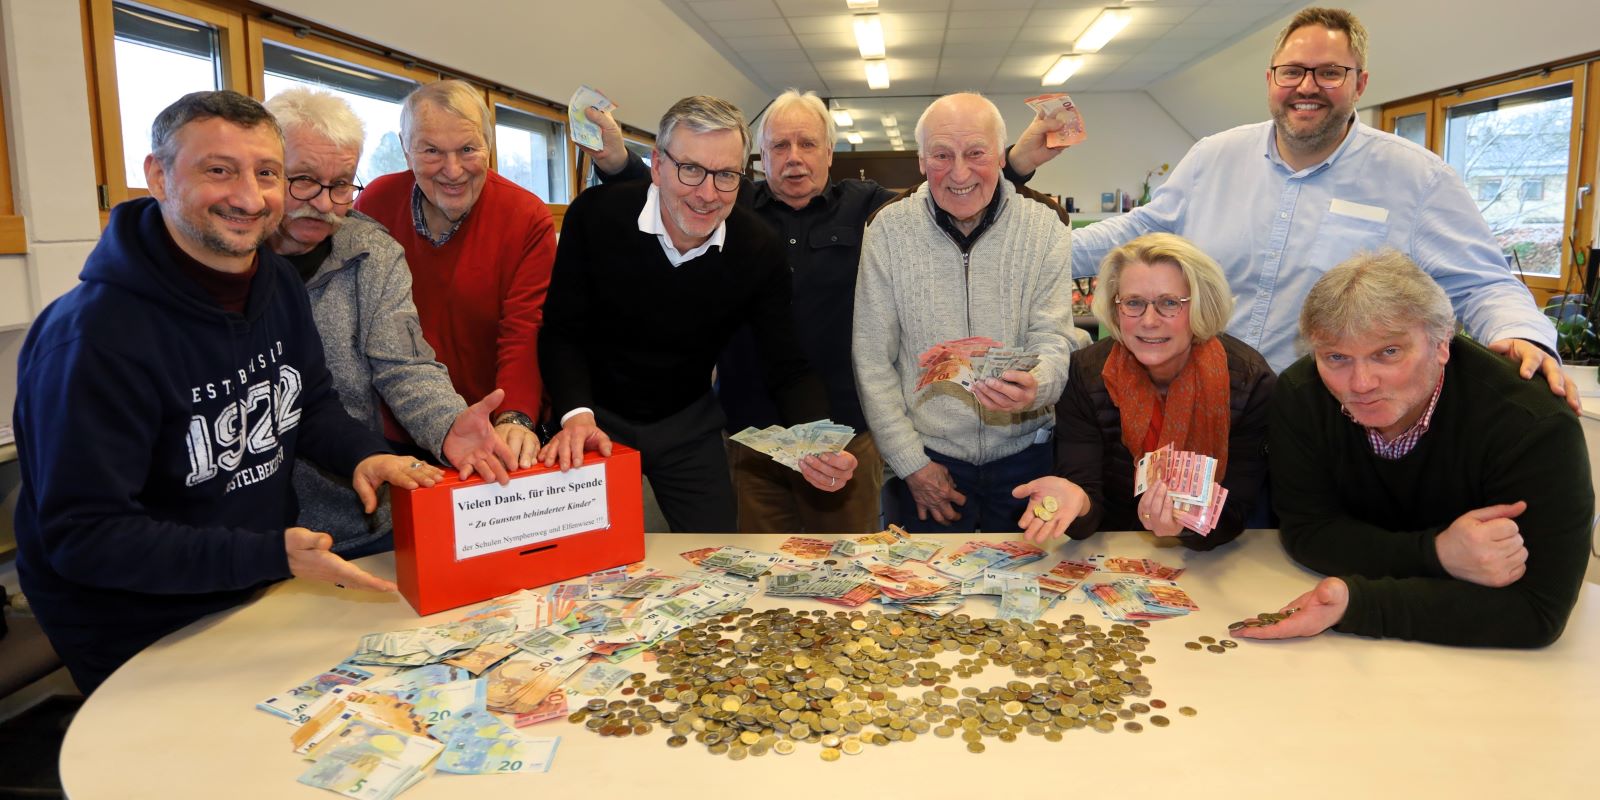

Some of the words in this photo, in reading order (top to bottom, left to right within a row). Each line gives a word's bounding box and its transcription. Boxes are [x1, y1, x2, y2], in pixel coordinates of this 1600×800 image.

[186, 364, 302, 487] 1922
[458, 498, 492, 512] Vielen
[494, 492, 526, 505] Dank,
[529, 489, 544, 499] für
[546, 486, 566, 496] ihre
[568, 478, 602, 492] Spende
[475, 520, 487, 529] Zu
[489, 514, 521, 526] Gunsten
[523, 505, 566, 520] behinderter
[475, 538, 502, 550] Schulen
[503, 528, 548, 544] Nymphenweg
[549, 526, 561, 534] und
[532, 661, 552, 672] 50
[548, 688, 564, 704] 10
[428, 710, 451, 722] 20
[498, 760, 522, 772] 20
[350, 778, 368, 793] 5
